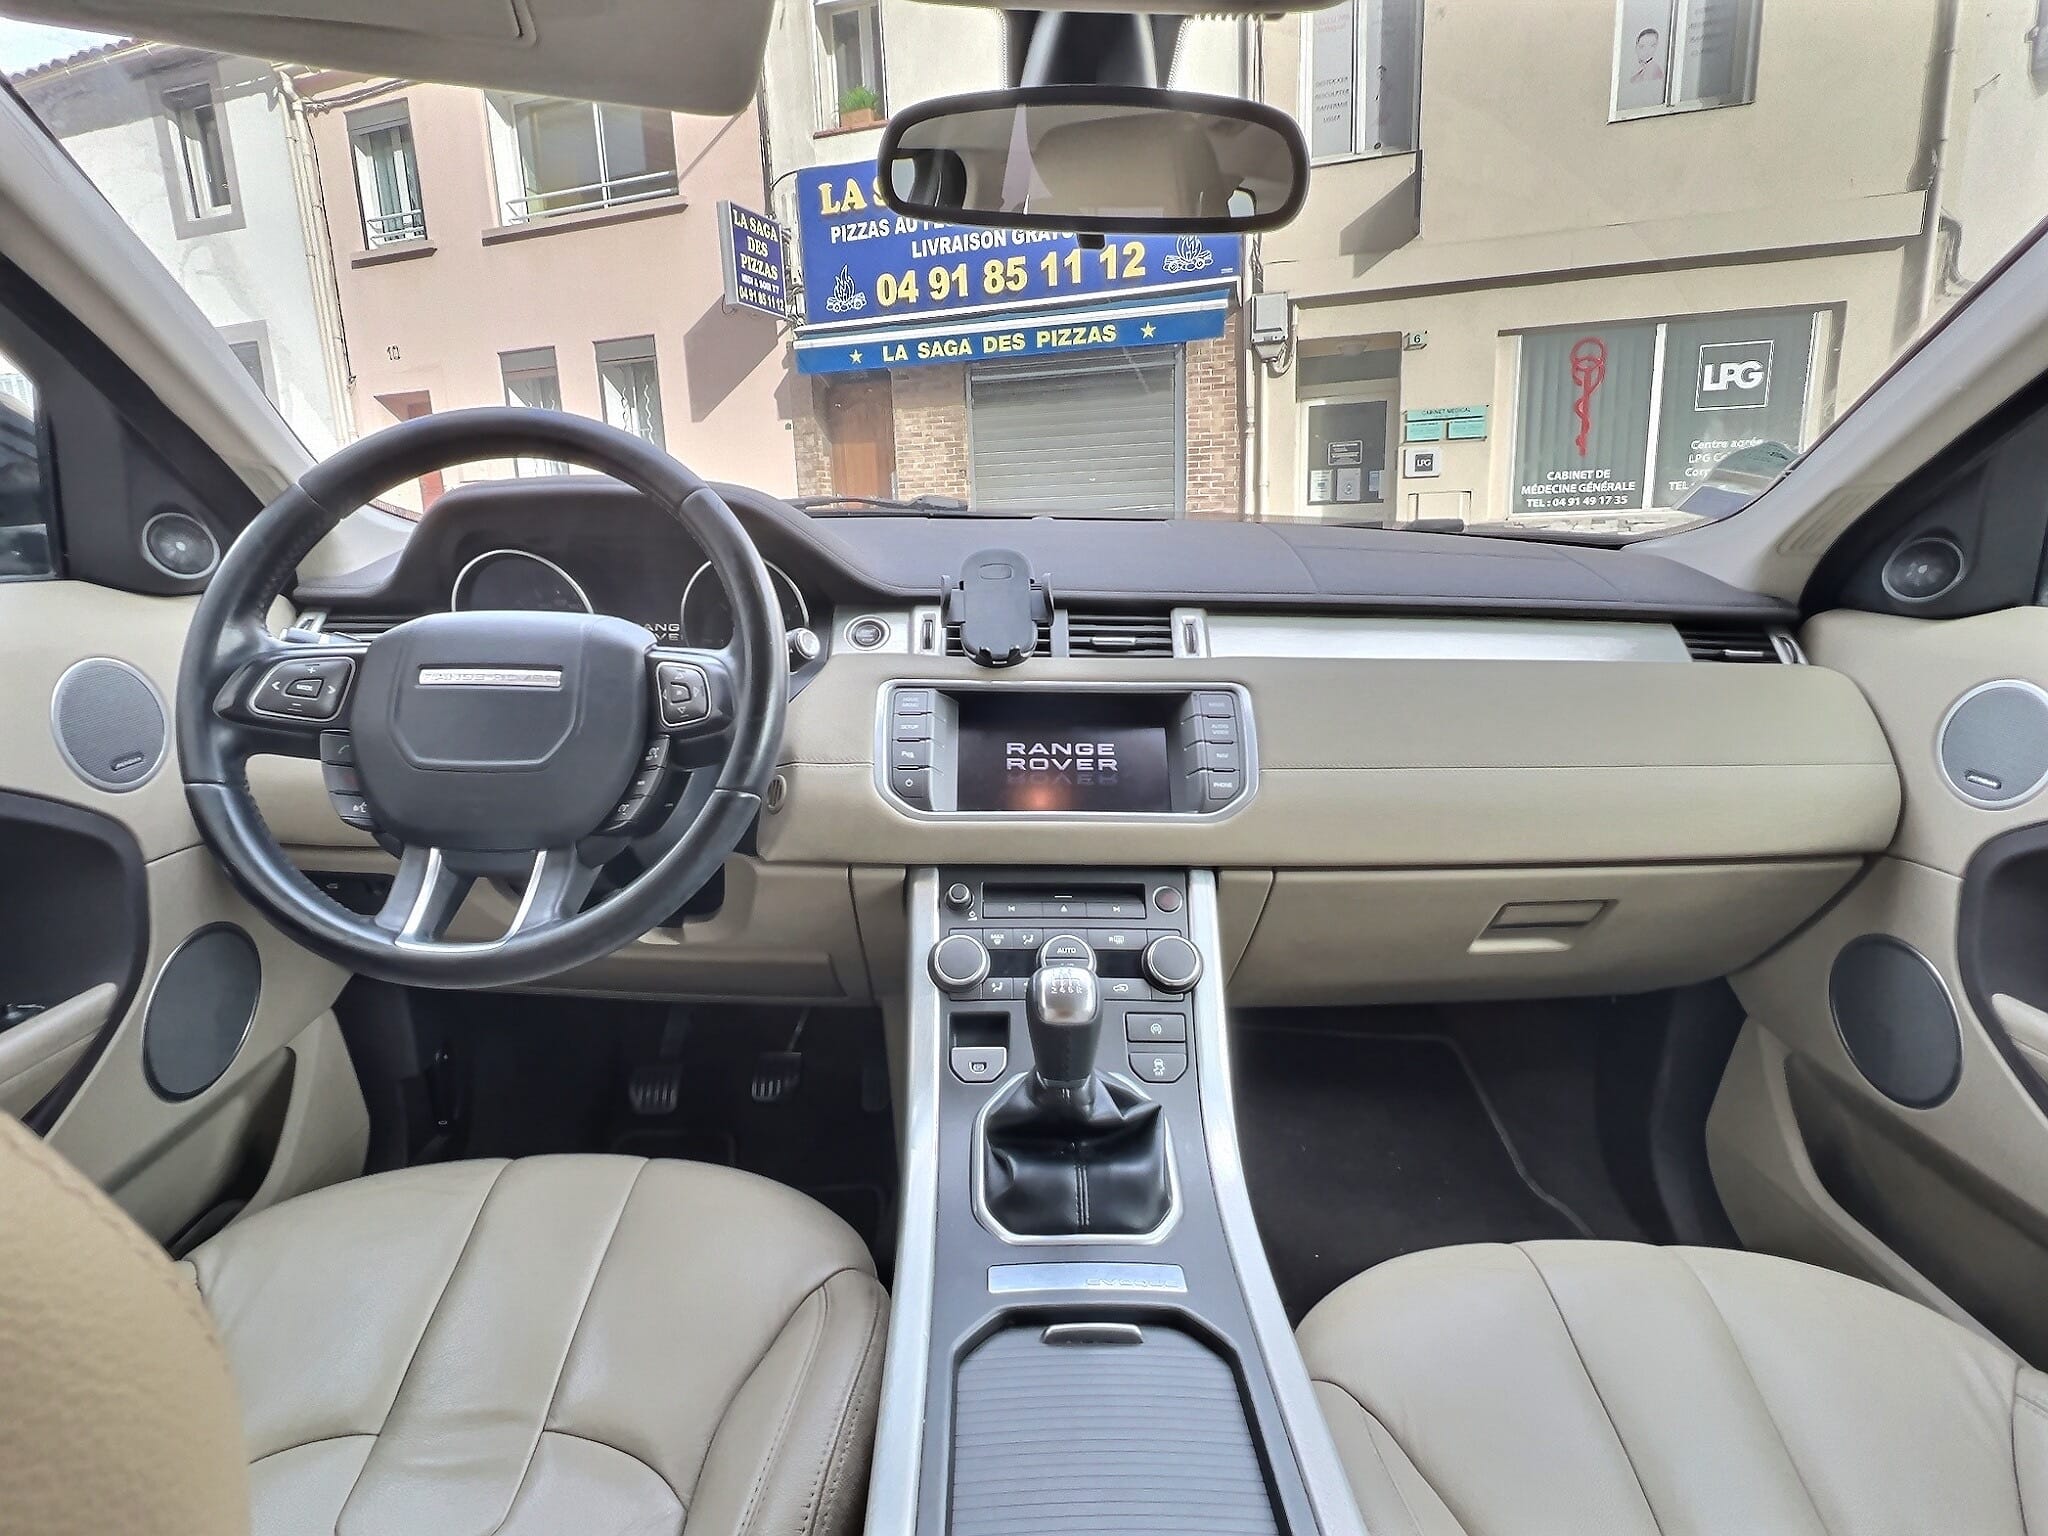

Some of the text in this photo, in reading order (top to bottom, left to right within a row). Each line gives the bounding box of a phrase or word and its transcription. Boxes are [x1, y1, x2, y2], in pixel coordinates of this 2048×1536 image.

[818, 178, 868, 215] LA
[732, 209, 779, 242] LA SAGA
[830, 218, 890, 244] PIZZAS
[894, 216, 918, 235] AU
[747, 235, 768, 257] DES
[911, 229, 1007, 259] LIVRAISON
[740, 253, 779, 281] PIZZAS
[876, 241, 1146, 307] 04 91 85 11 12
[739, 285, 748, 300] 04
[748, 287, 757, 303] 91
[882, 325, 1117, 363] LA SAGA DES PIZZAS
[1413, 334, 1421, 344] 6
[1703, 359, 1765, 391] LPG
[1690, 440, 1728, 450] Centre
[1417, 459, 1431, 467] LPG
[1688, 453, 1711, 464] LPG
[1546, 469, 1611, 481] CABINET DE
[1521, 480, 1636, 495] MÉDECINE GÉNÉRALE
[1668, 481, 1688, 490] TEL
[1552, 498, 1566, 507] 04
[1567, 497, 1580, 507] 91
[1582, 496, 1597, 506] 49
[1599, 495, 1612, 505] 17
[1613, 495, 1629, 505] 35
[1006, 742, 1115, 756] RANGE
[1006, 757, 1118, 771] ROVER
